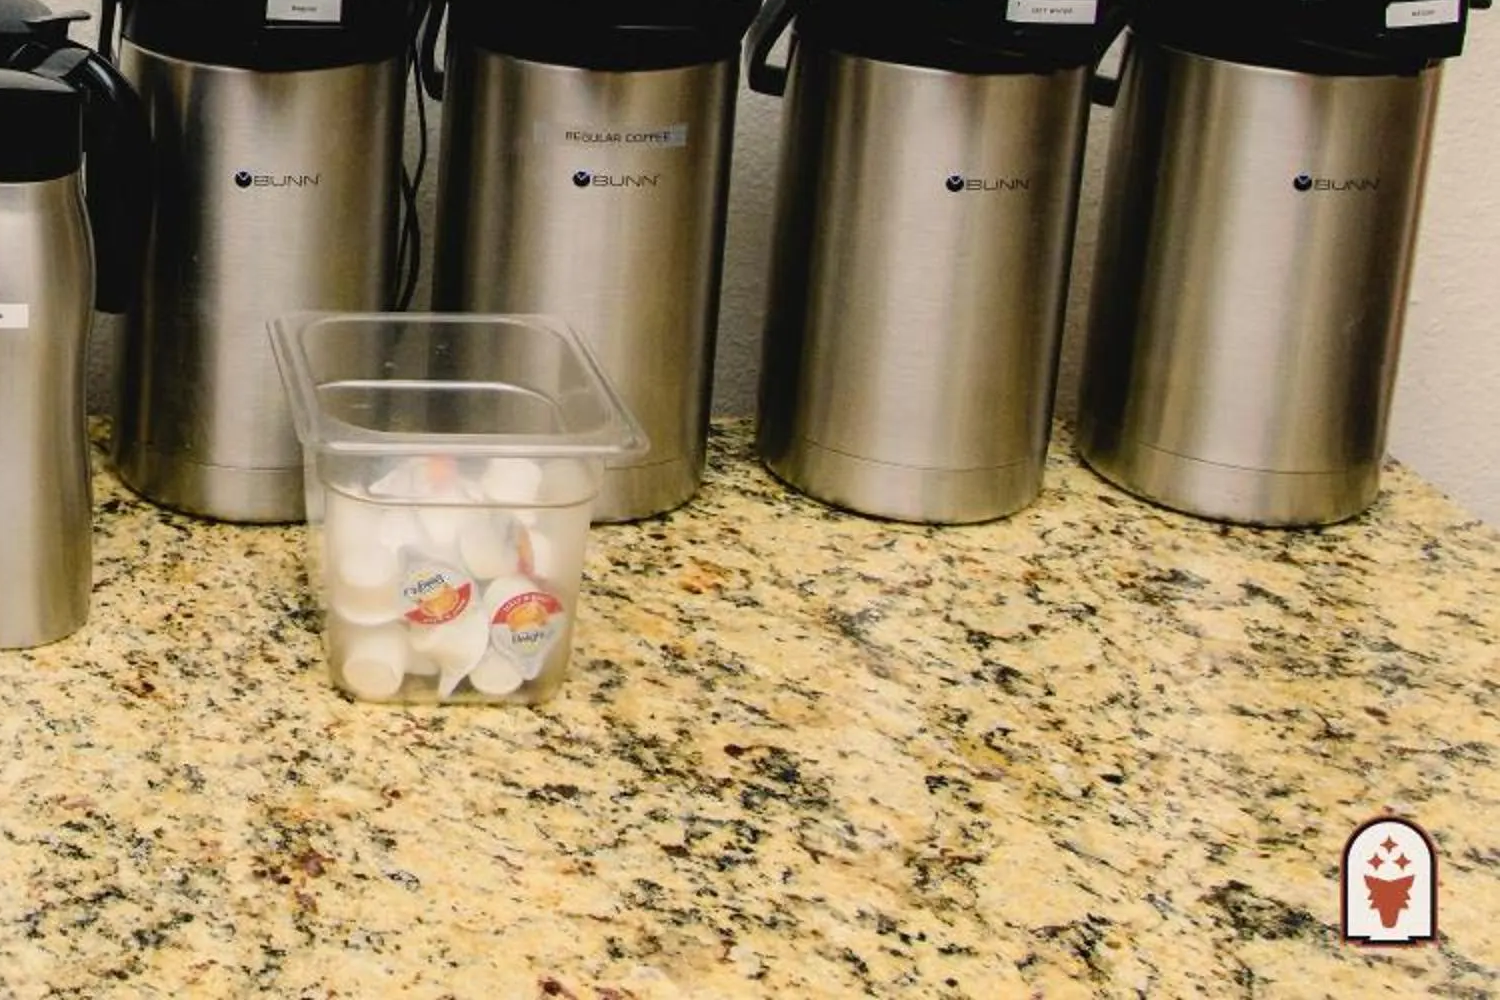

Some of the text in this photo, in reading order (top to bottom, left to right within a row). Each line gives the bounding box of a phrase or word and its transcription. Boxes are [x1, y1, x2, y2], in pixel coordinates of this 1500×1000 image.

[254, 173, 320, 187] BUNN
[592, 174, 660, 187] BUNN
[965, 177, 1029, 191] BUNN
[1314, 177, 1380, 191] BUNN
